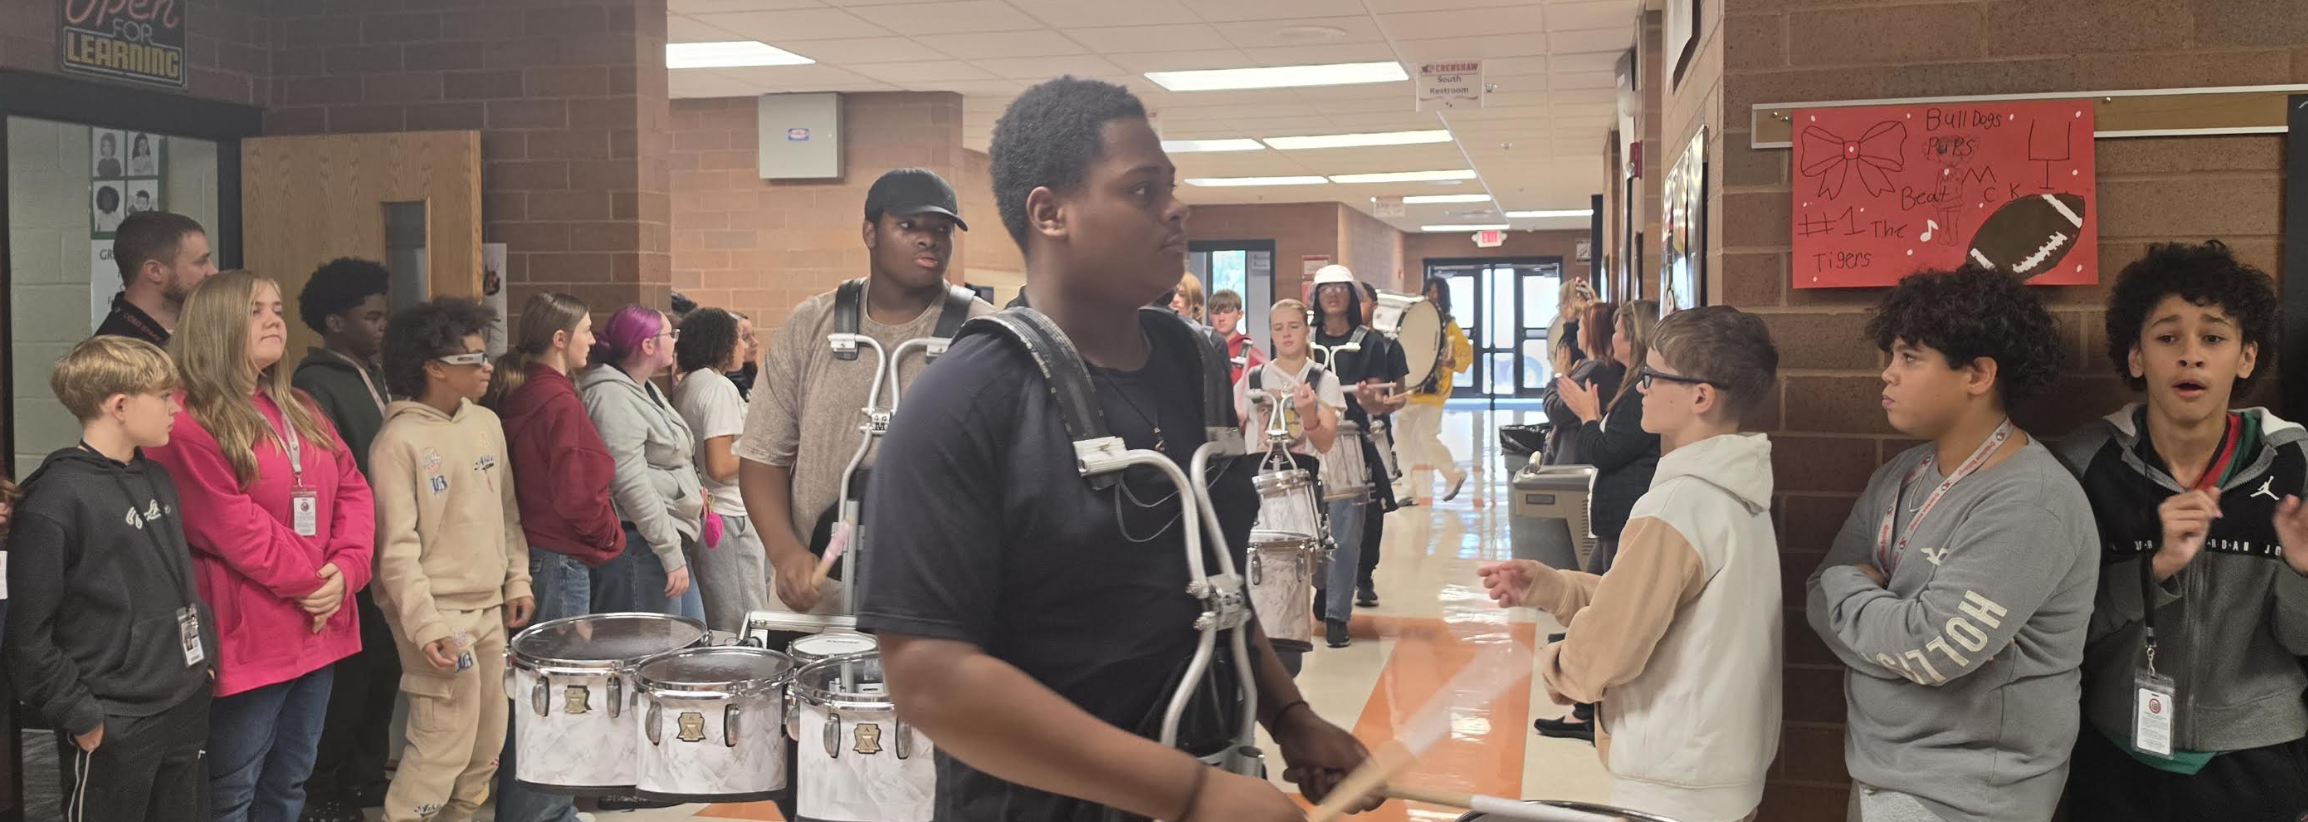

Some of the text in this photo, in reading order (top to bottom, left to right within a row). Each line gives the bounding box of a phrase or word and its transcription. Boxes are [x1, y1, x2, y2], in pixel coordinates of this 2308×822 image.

[113, 19, 152, 42] FOR
[67, 32, 179, 78] LEARNING
[1435, 63, 1478, 73] CRENSHAW
[1437, 75, 1461, 83] South
[1430, 87, 1469, 95] Restroom
[1901, 186, 1949, 211] Beat
[1871, 219, 1907, 238] The
[1813, 251, 1871, 272] Tigers
